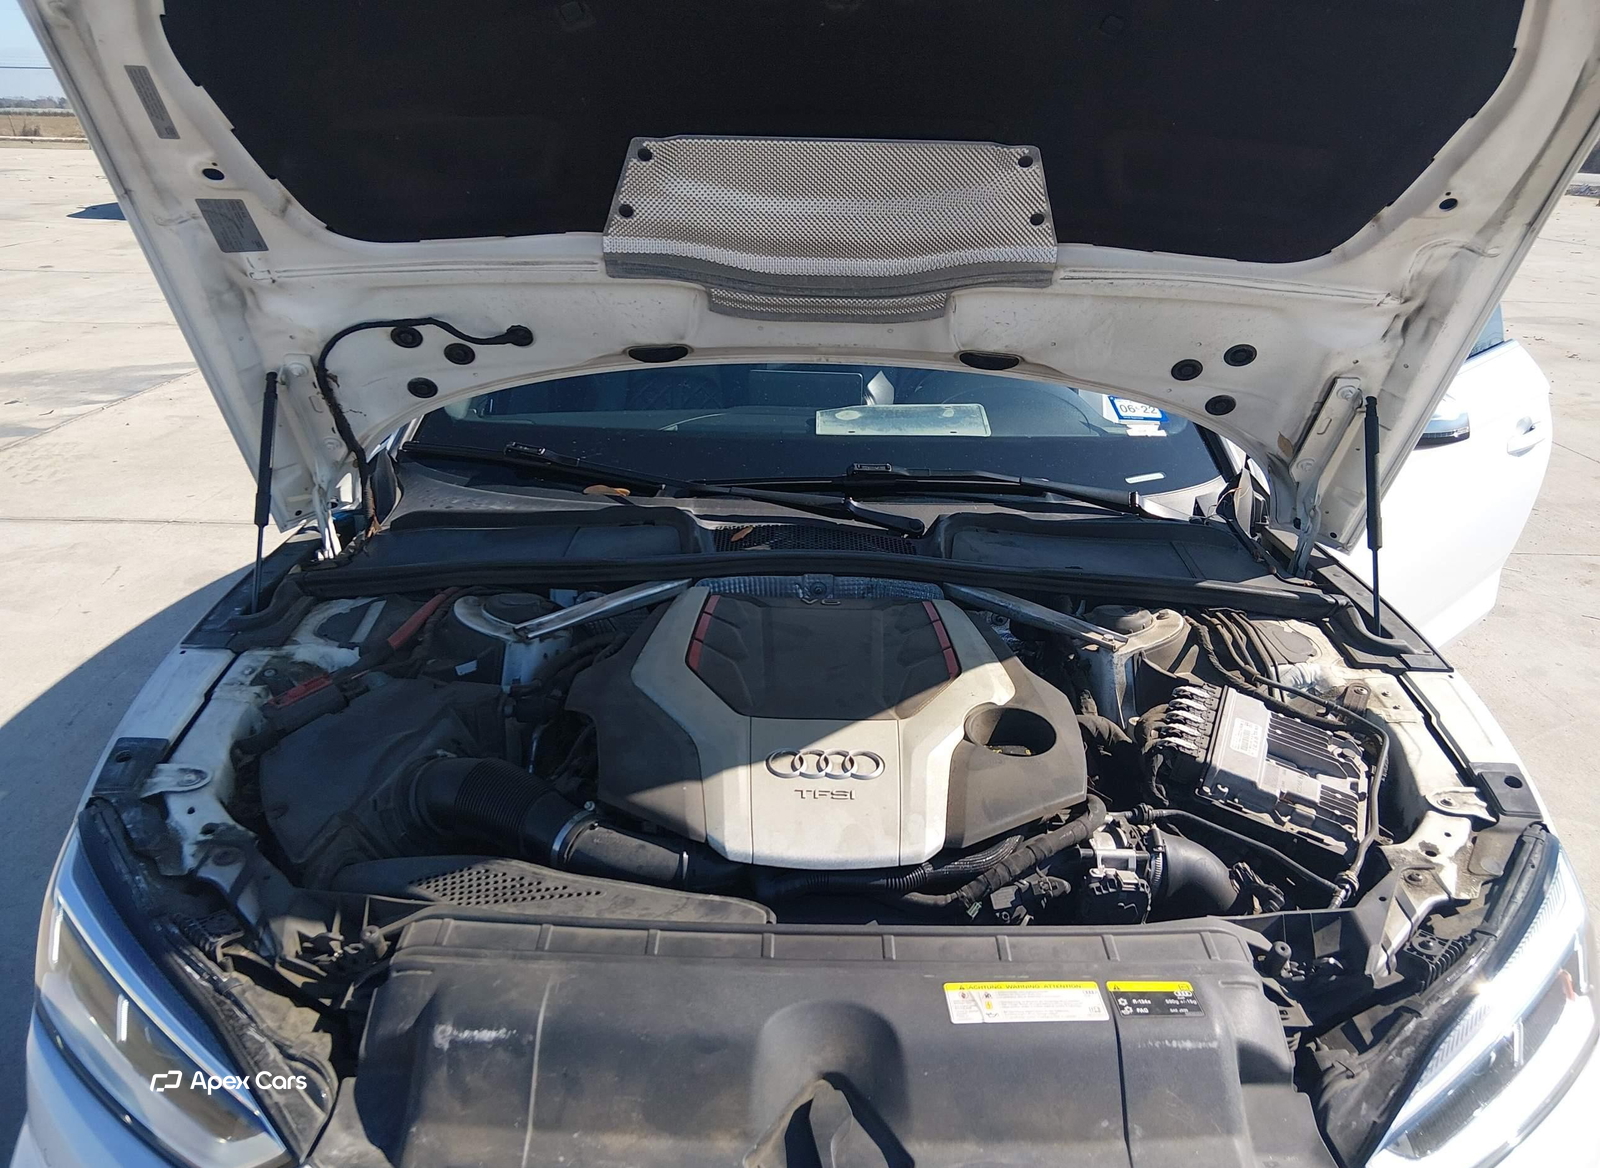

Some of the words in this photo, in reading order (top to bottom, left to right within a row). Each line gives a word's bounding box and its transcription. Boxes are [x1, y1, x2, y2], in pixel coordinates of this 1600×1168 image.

[1119, 404, 1136, 413] 06
[1140, 405, 1158, 414] 22
[794, 789, 856, 801] TFSI
